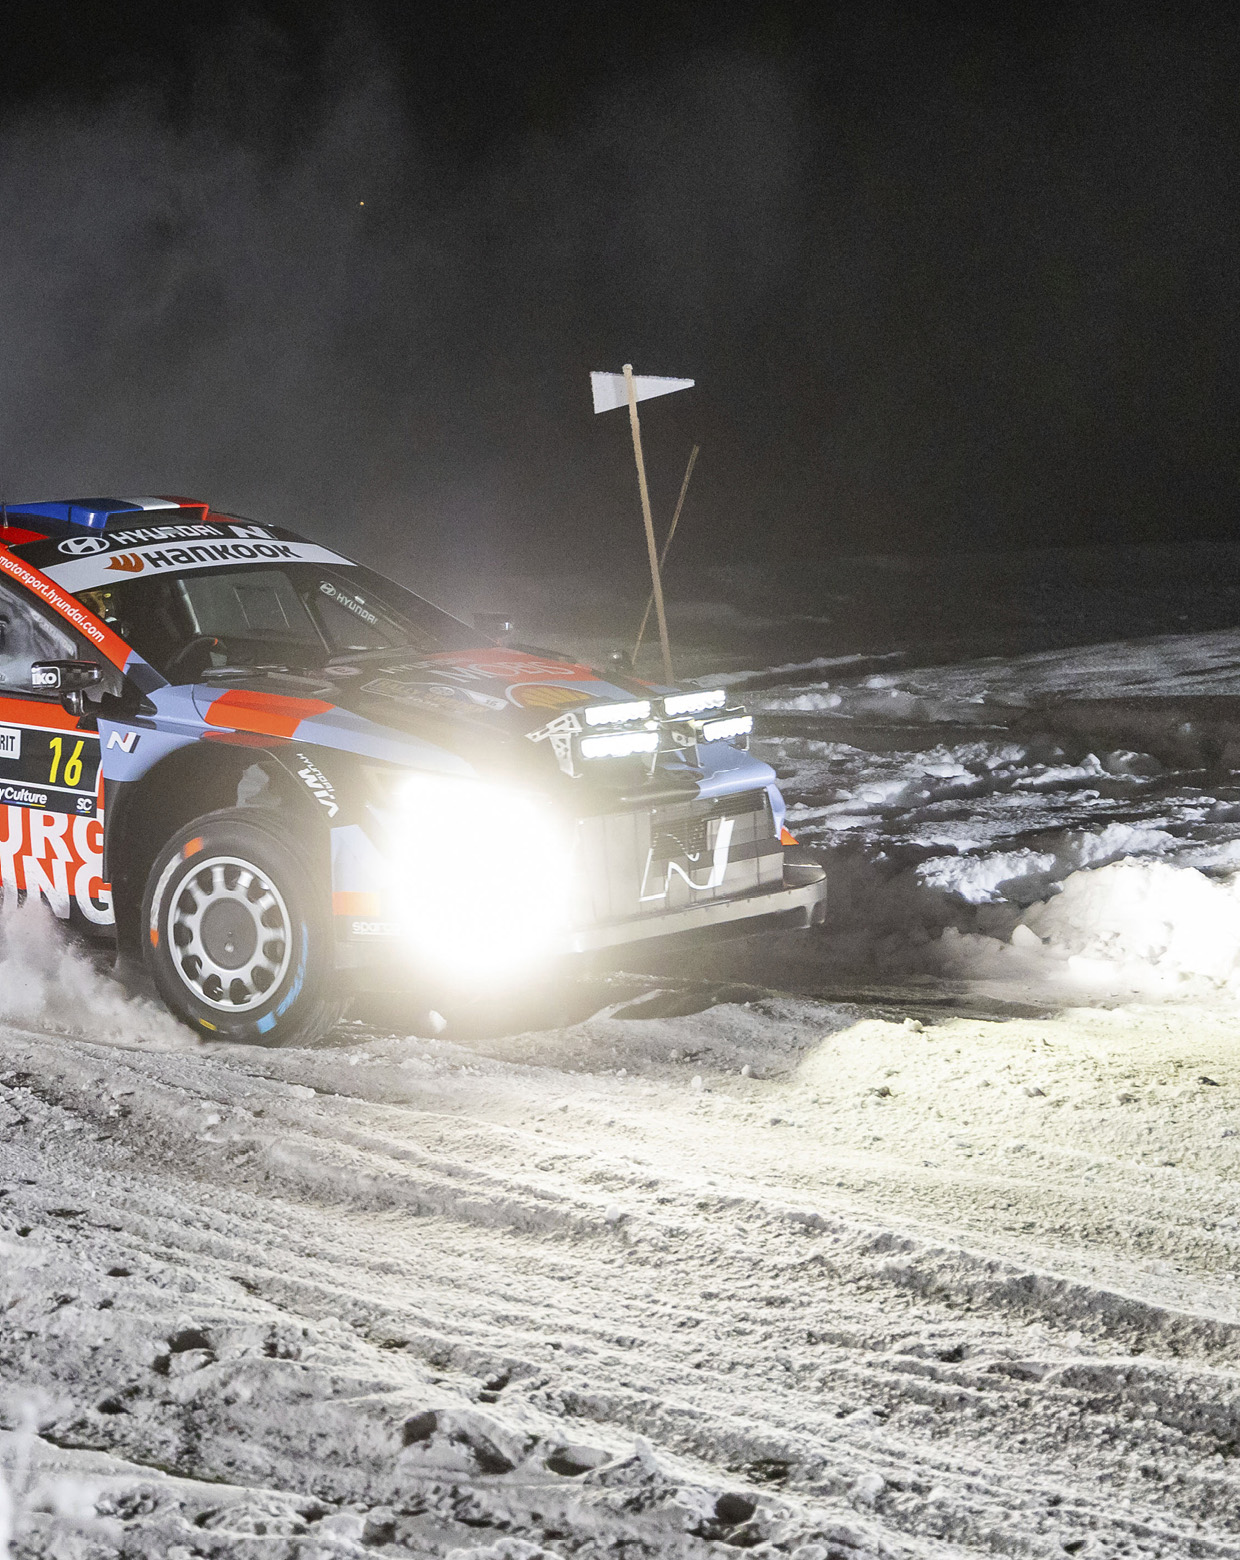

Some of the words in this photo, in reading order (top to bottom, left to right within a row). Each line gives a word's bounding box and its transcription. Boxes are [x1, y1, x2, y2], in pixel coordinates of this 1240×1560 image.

[109, 524, 225, 545] HYUNDAI
[336, 592, 377, 625] HYUNDAI
[49, 737, 85, 787] 16
[296, 753, 335, 792] HYUNDAI
[76, 798, 92, 812] SC
